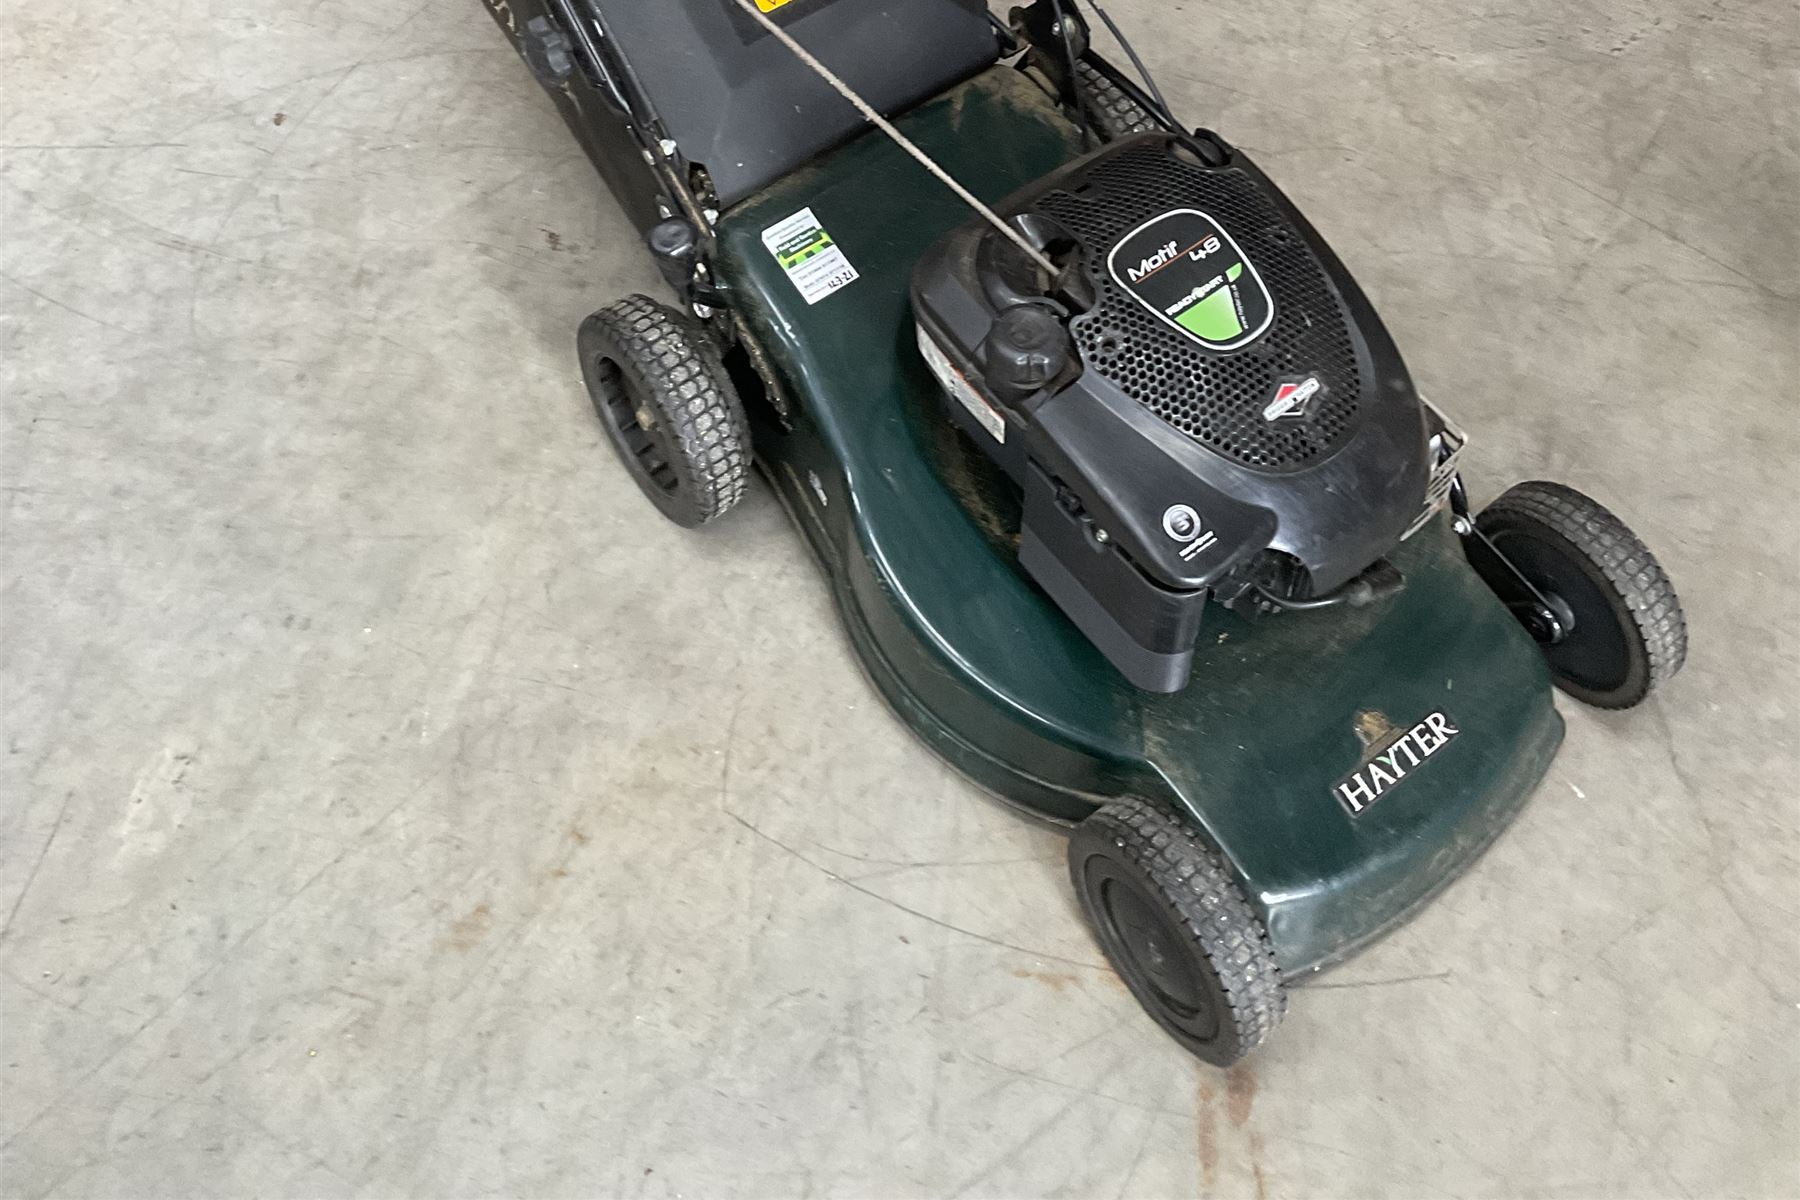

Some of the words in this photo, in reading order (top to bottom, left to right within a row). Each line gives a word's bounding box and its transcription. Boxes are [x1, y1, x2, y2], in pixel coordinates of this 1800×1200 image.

[1127, 240, 1179, 282] Motif
[1188, 236, 1221, 262] 48
[1338, 712, 1460, 812] HAYTER
